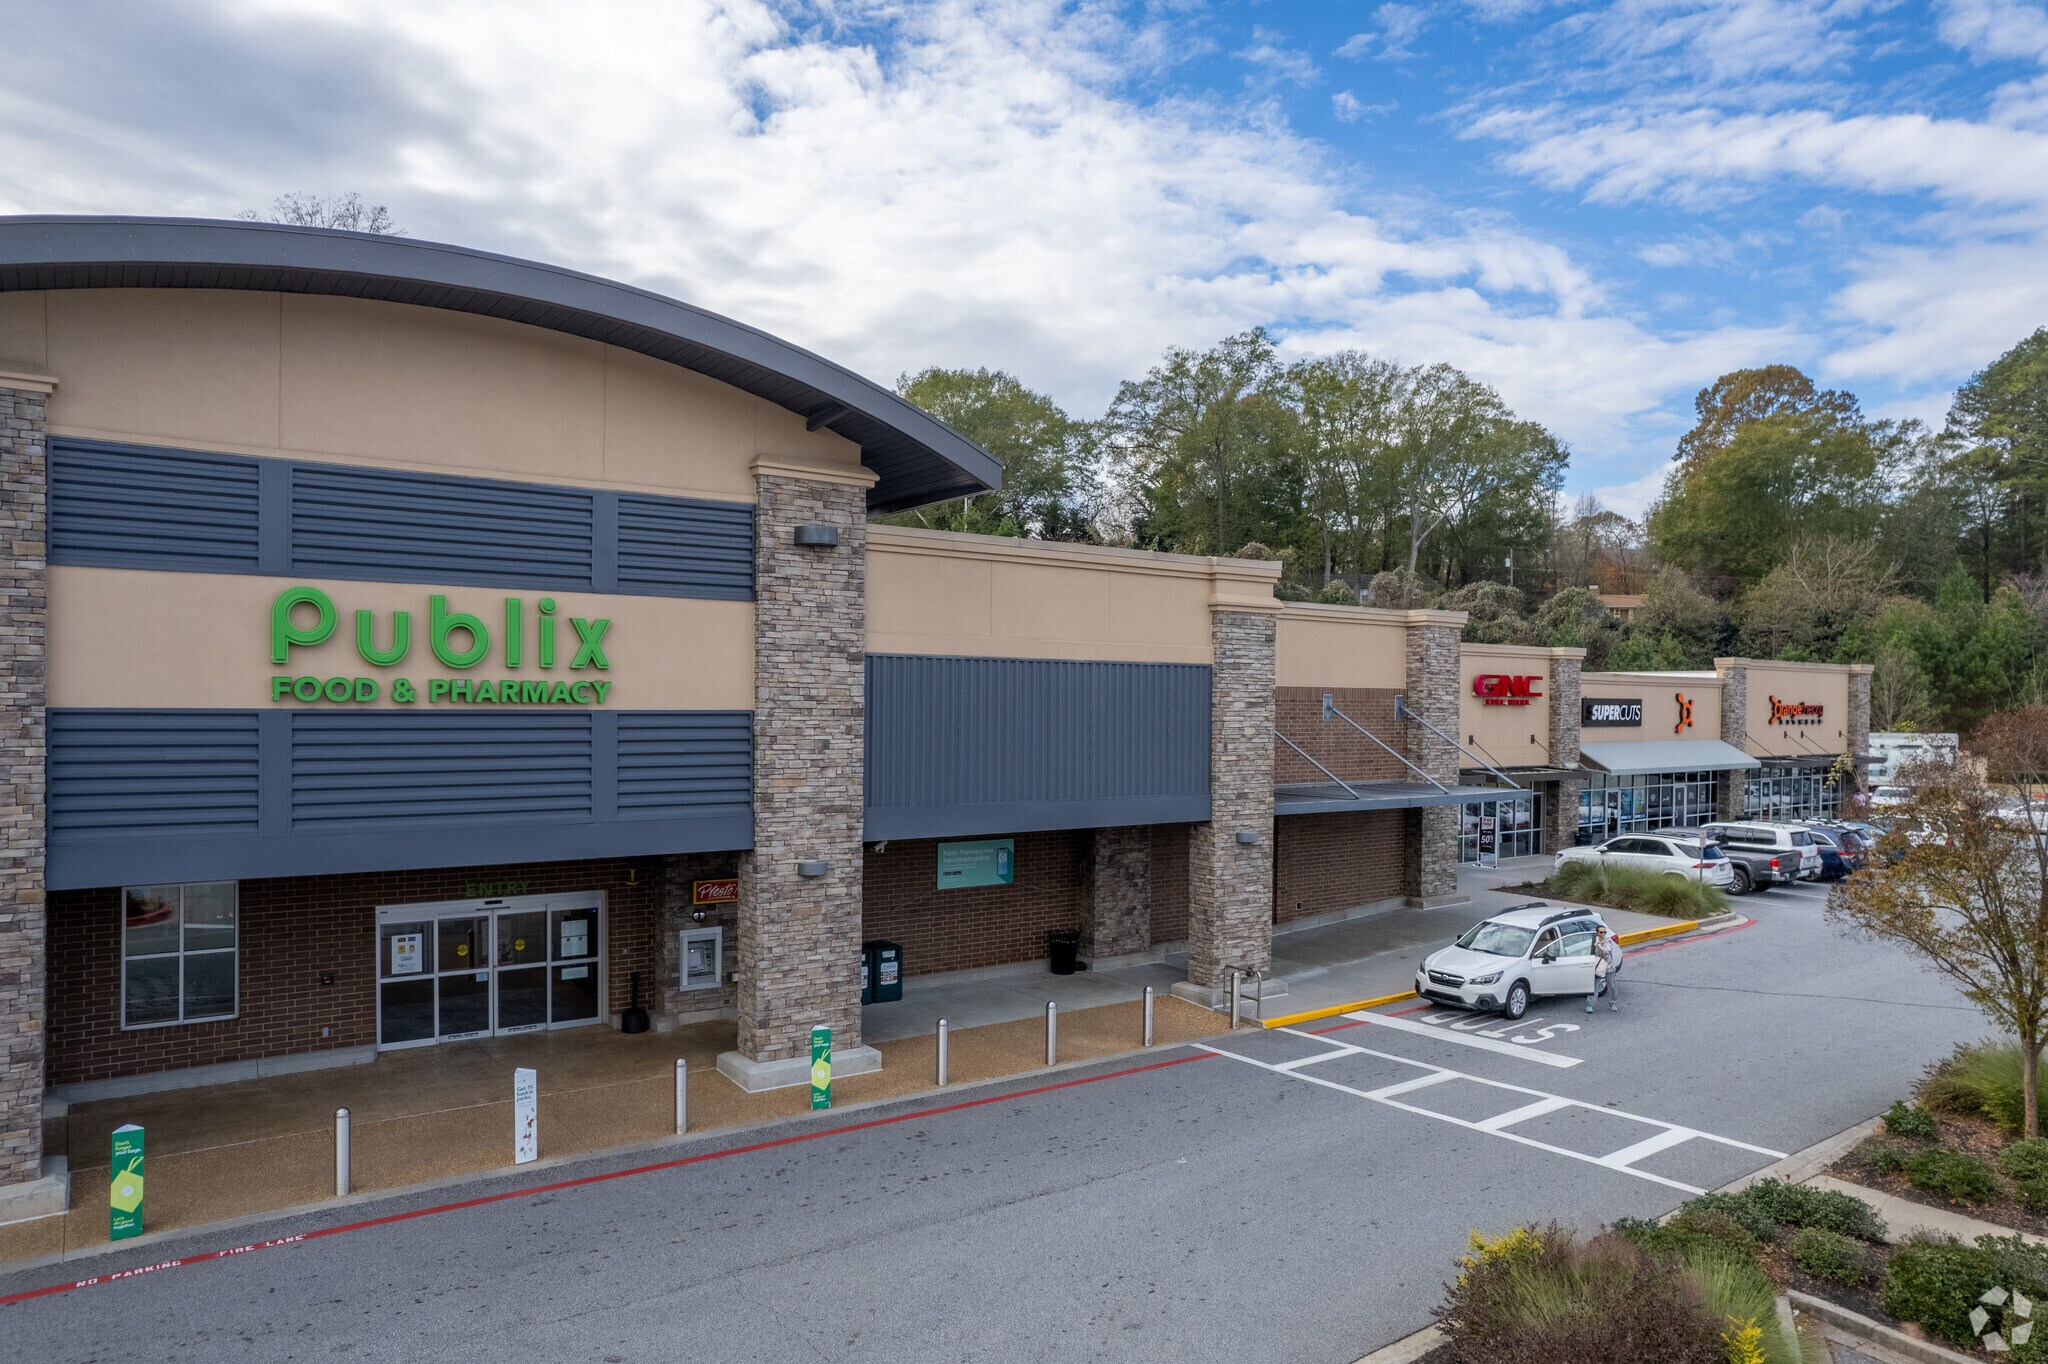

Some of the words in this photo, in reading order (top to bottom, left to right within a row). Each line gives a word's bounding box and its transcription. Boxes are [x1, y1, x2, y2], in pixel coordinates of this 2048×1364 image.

[271, 586, 611, 669] Publix
[271, 676, 379, 703] FOOD
[391, 677, 416, 703] &
[429, 678, 612, 705] PHARMACY
[1473, 674, 1543, 697] GNC
[1591, 704, 1641, 721] SUPERCUTS
[943, 849, 958, 857] Publix
[465, 879, 530, 899] ENTRY
[76, 1277, 98, 1288] NO
[111, 1259, 182, 1280] PARKING
[219, 1244, 255, 1257] FIRE
[265, 1234, 307, 1247] LANE
